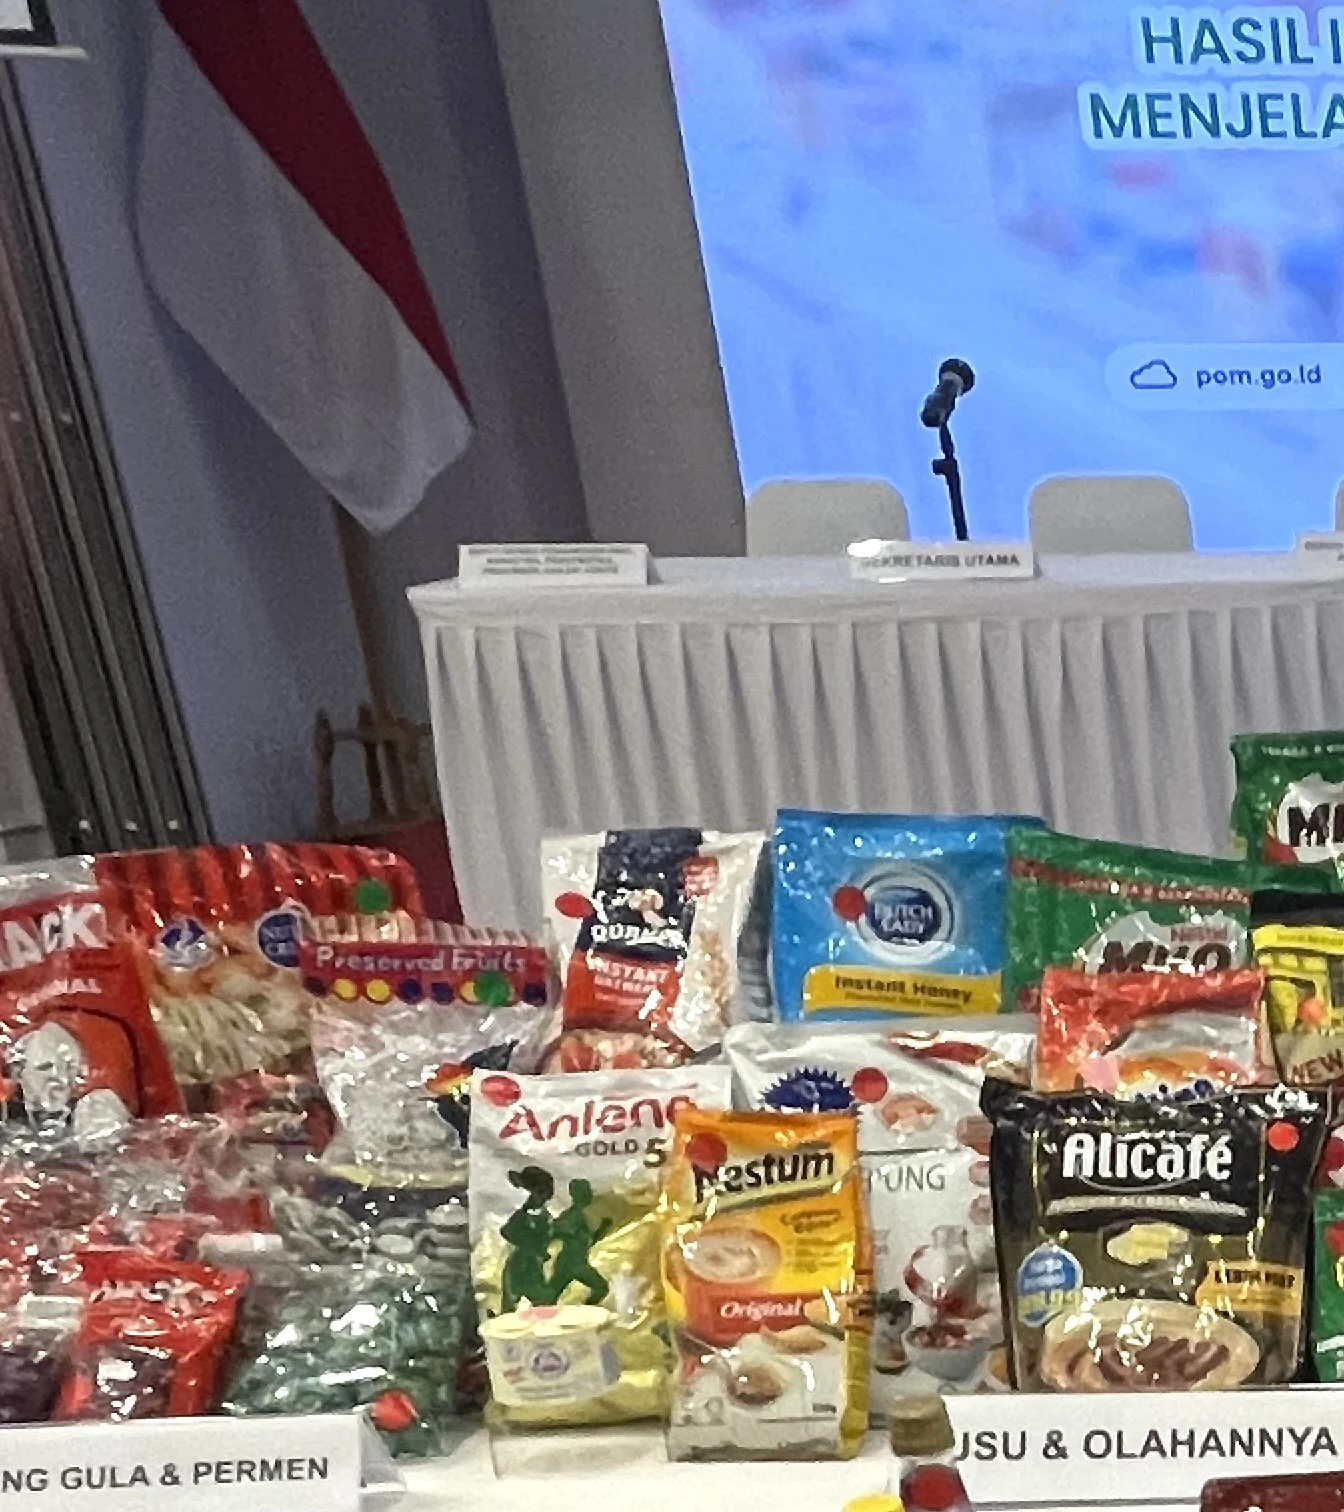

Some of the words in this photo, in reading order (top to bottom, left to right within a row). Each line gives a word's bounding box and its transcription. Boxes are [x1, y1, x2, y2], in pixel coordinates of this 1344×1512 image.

[1141, 17, 1313, 64] HASIL
[0, 904, 108, 970] ACK
[643, 1135, 668, 1168] 5
[719, 1299, 801, 1321] Original
[952, 1430, 1029, 1462] USU
[1042, 1431, 1069, 1460] &
[1082, 1427, 1339, 1460] OLAHANNYA
[60, 1462, 151, 1492] GULA
[160, 1462, 182, 1487] &
[192, 1456, 330, 1486] PERMEN
